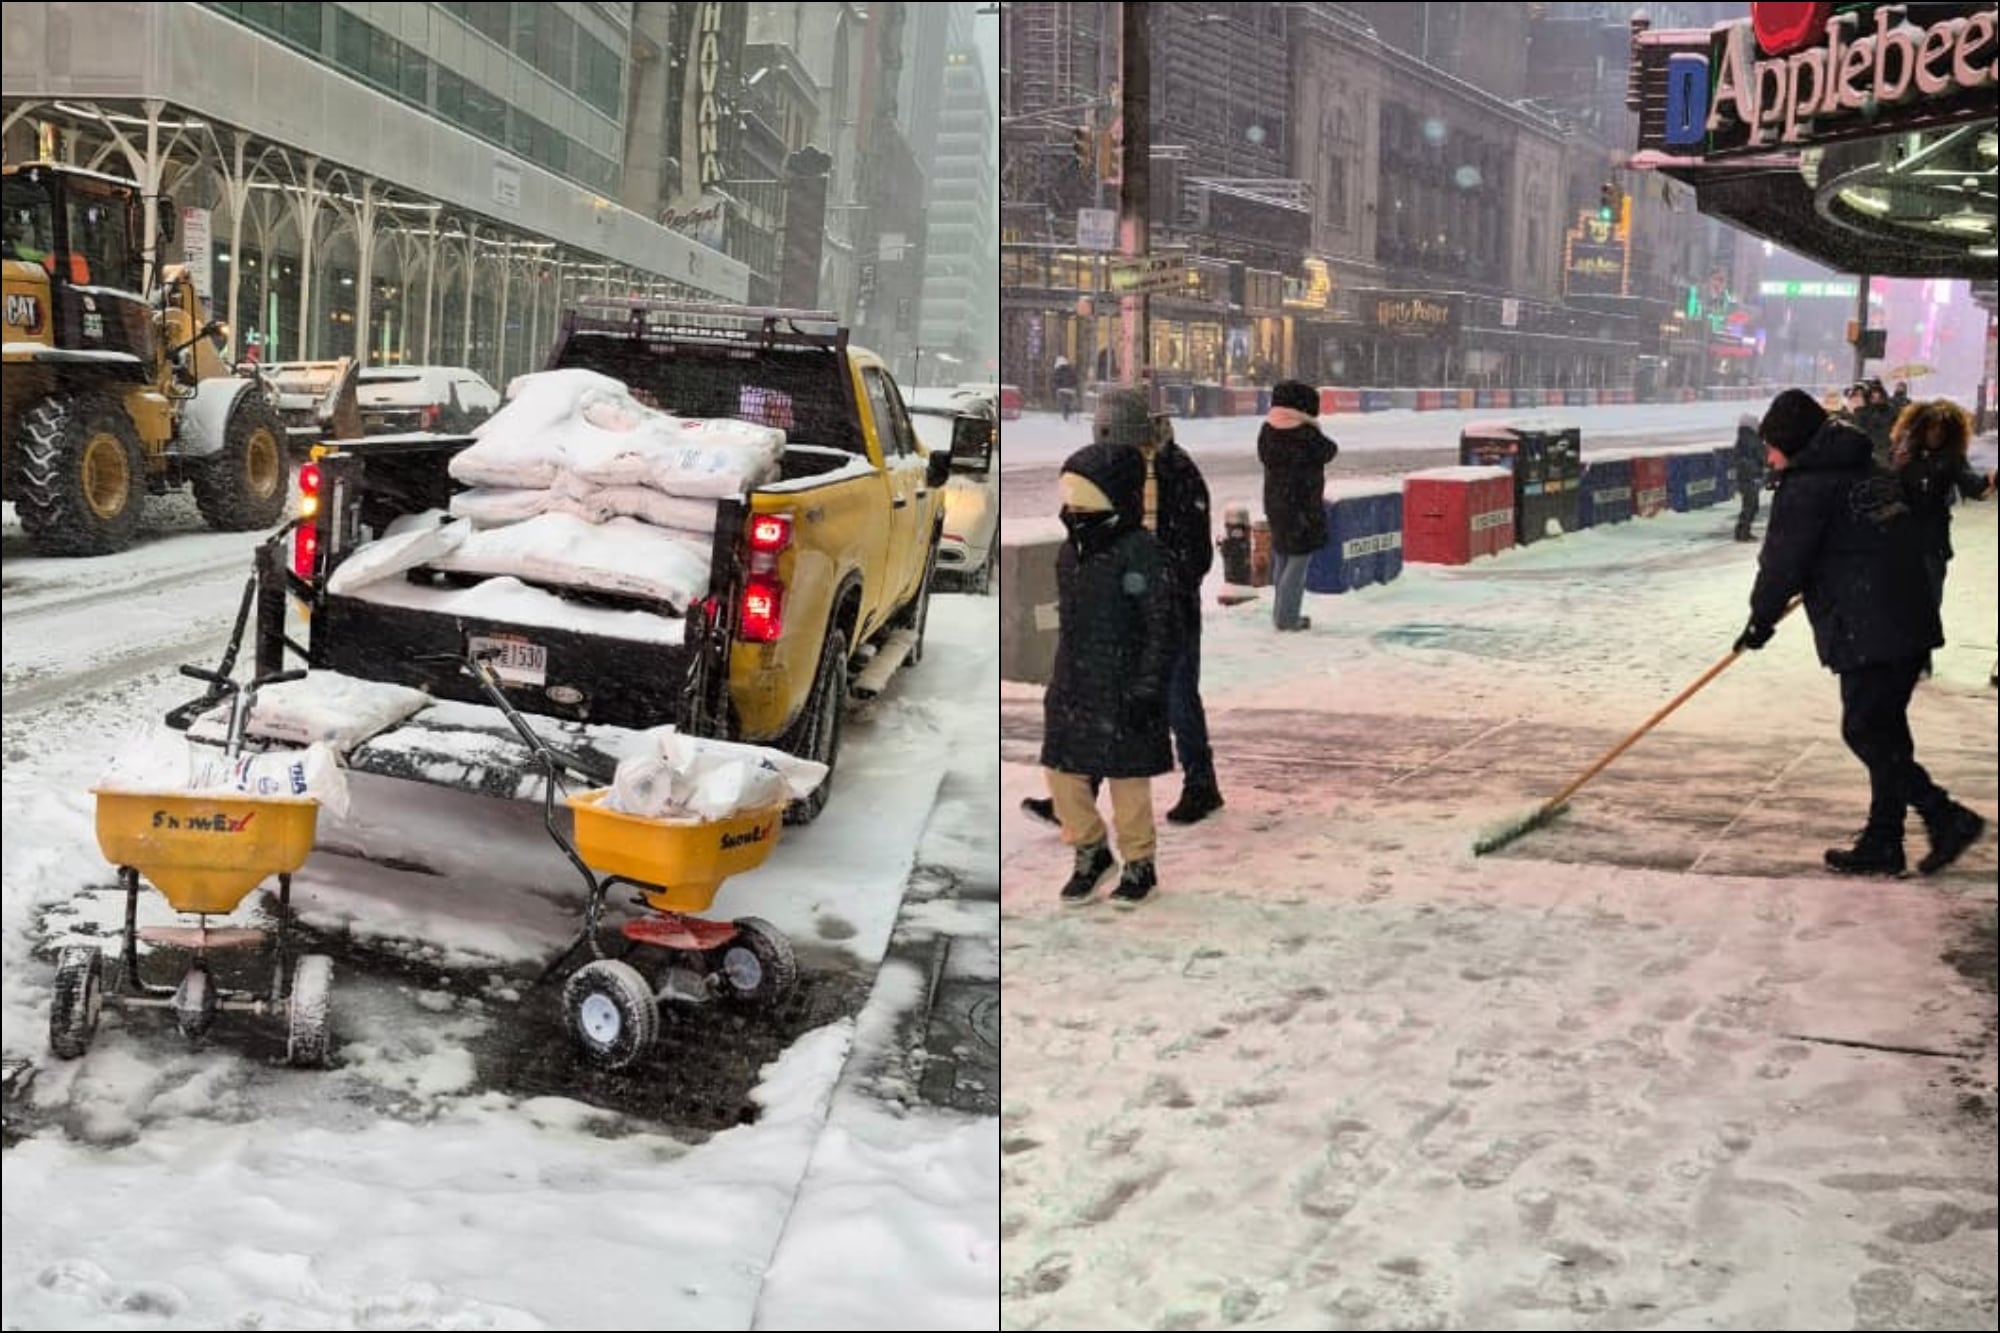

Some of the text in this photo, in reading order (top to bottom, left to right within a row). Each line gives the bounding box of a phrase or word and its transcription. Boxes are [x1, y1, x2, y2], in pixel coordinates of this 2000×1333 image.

[700, 2, 720, 182] HAVANA
[1705, 5, 1998, 146] Applebee
[6, 294, 36, 327] CAT
[651, 326, 747, 339] BACKRACK
